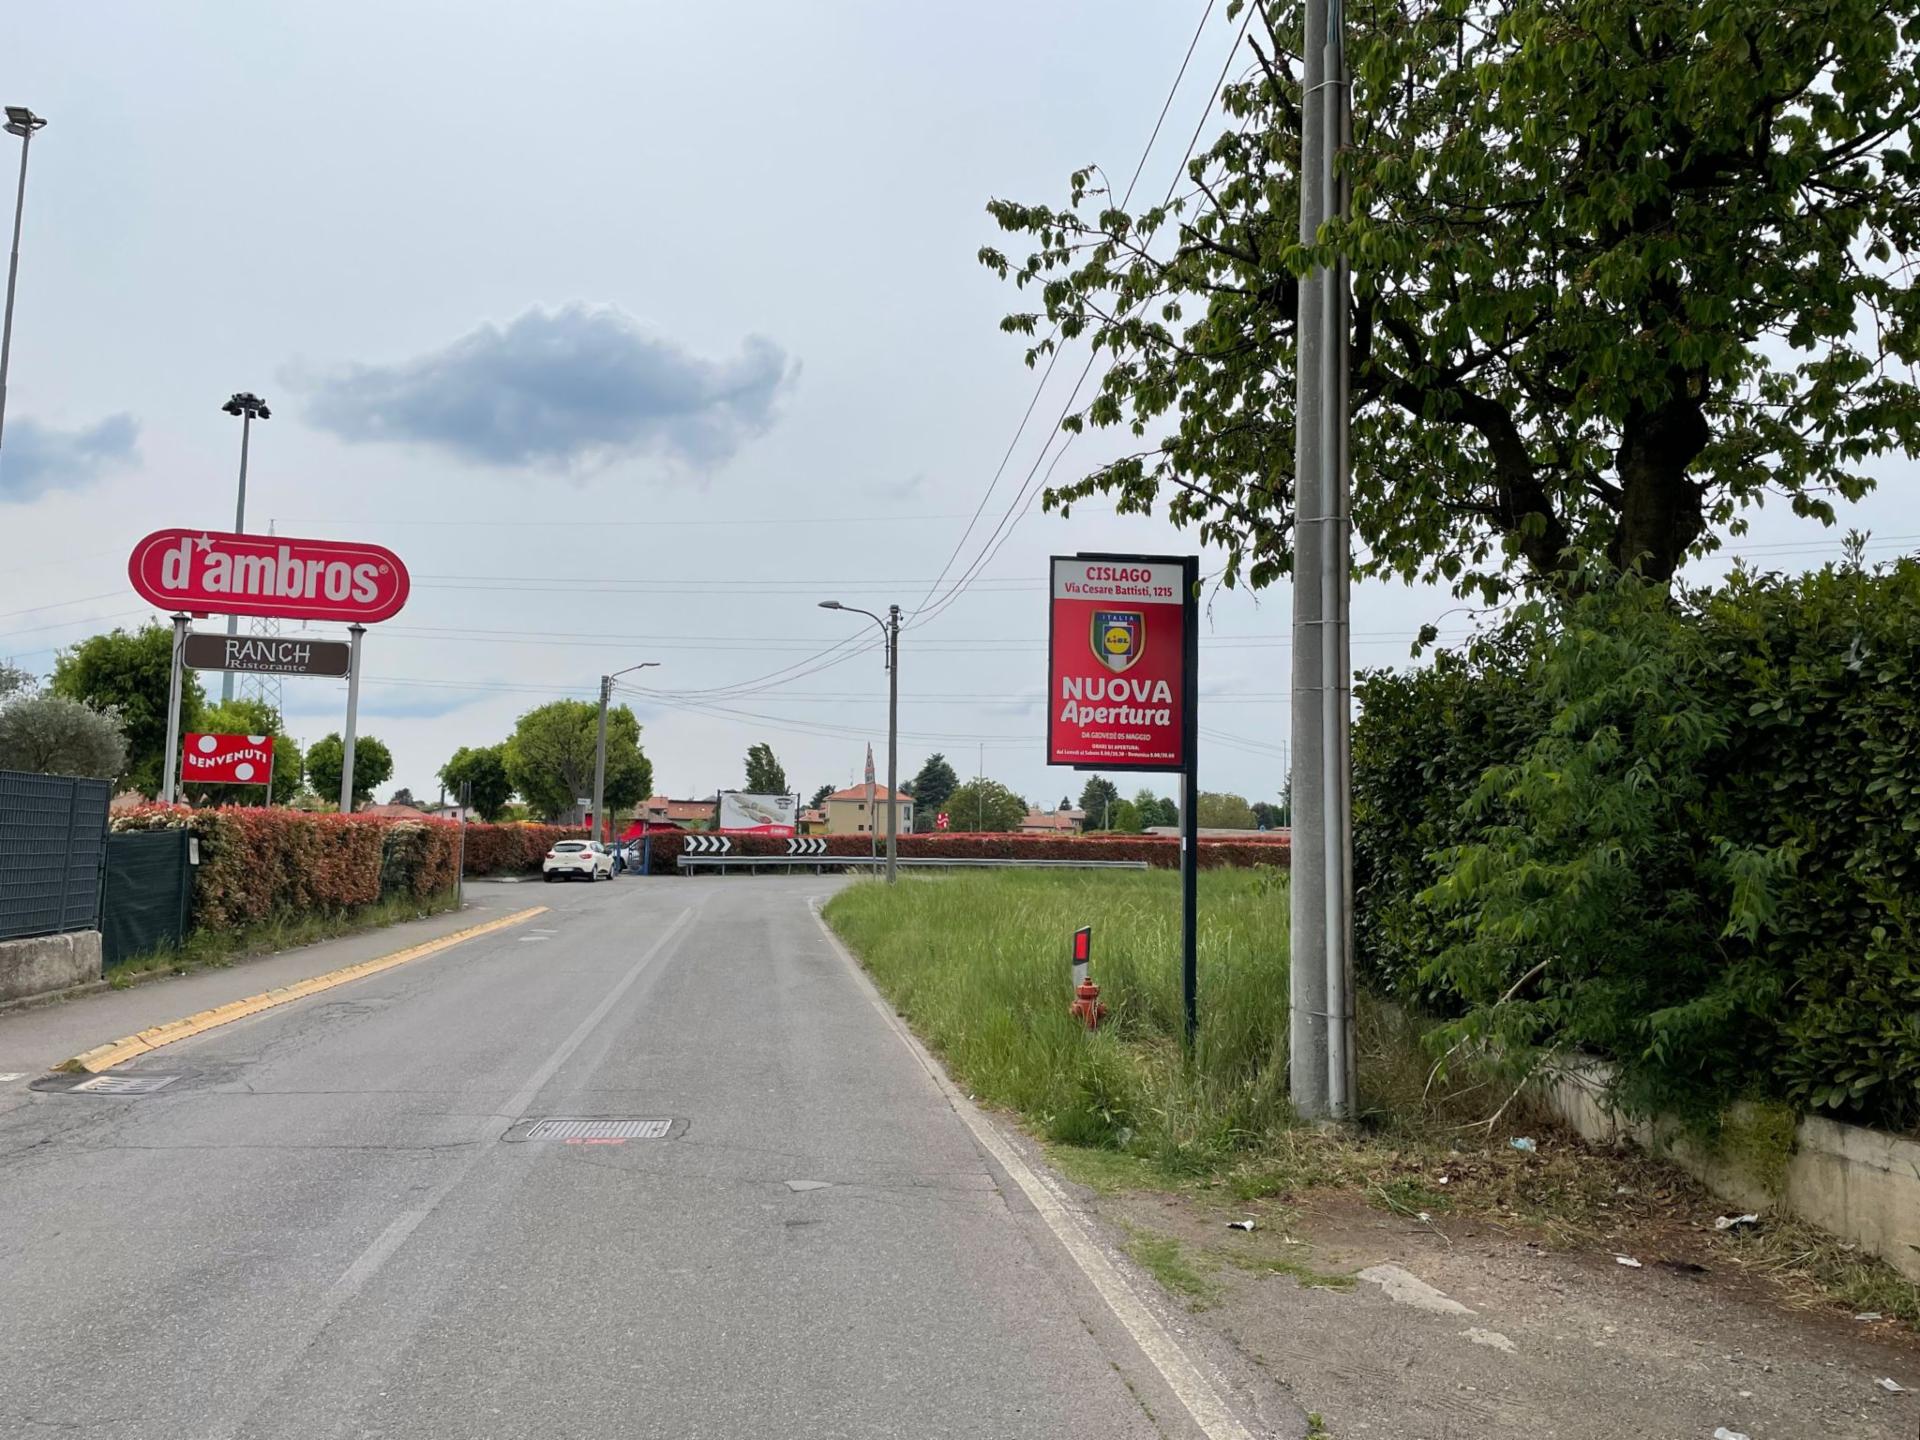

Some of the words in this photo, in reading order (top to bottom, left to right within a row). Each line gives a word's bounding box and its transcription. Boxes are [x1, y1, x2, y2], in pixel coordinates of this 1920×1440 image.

[1086, 567, 1152, 582] CISLAGO
[1065, 583, 1080, 593] Via
[1082, 584, 1113, 595] Cesare
[1115, 586, 1152, 598] Battisti,
[1154, 587, 1173, 597] 1215
[225, 639, 310, 666] RANCH
[229, 659, 307, 672] Ristorante
[1062, 676, 1173, 704] NUOVA
[1060, 700, 1171, 728] Apertura
[1081, 731, 1090, 739] DA
[1118, 732, 1125, 740] 05
[1126, 733, 1151, 741] MAGGIO
[189, 749, 267, 768] BENVENUTI
